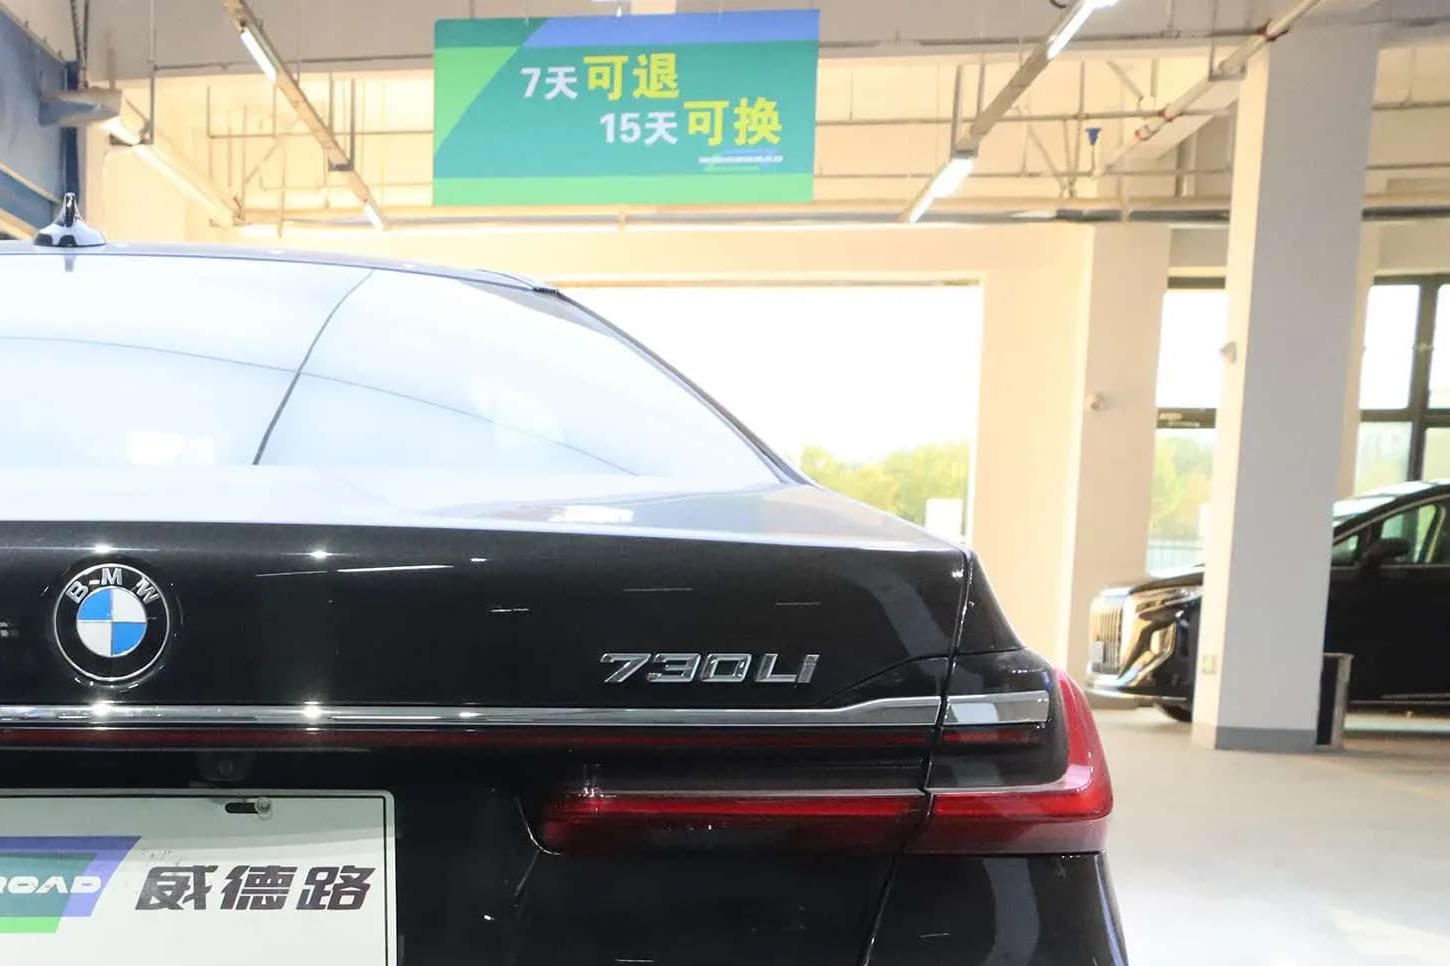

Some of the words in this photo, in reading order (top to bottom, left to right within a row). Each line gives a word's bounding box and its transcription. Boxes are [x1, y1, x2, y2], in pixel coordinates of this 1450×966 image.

[520, 53, 680, 101] 7天可退
[600, 96, 783, 146] 15天可换
[66, 567, 159, 604] BMW
[134, 865, 376, 910] 威德路
